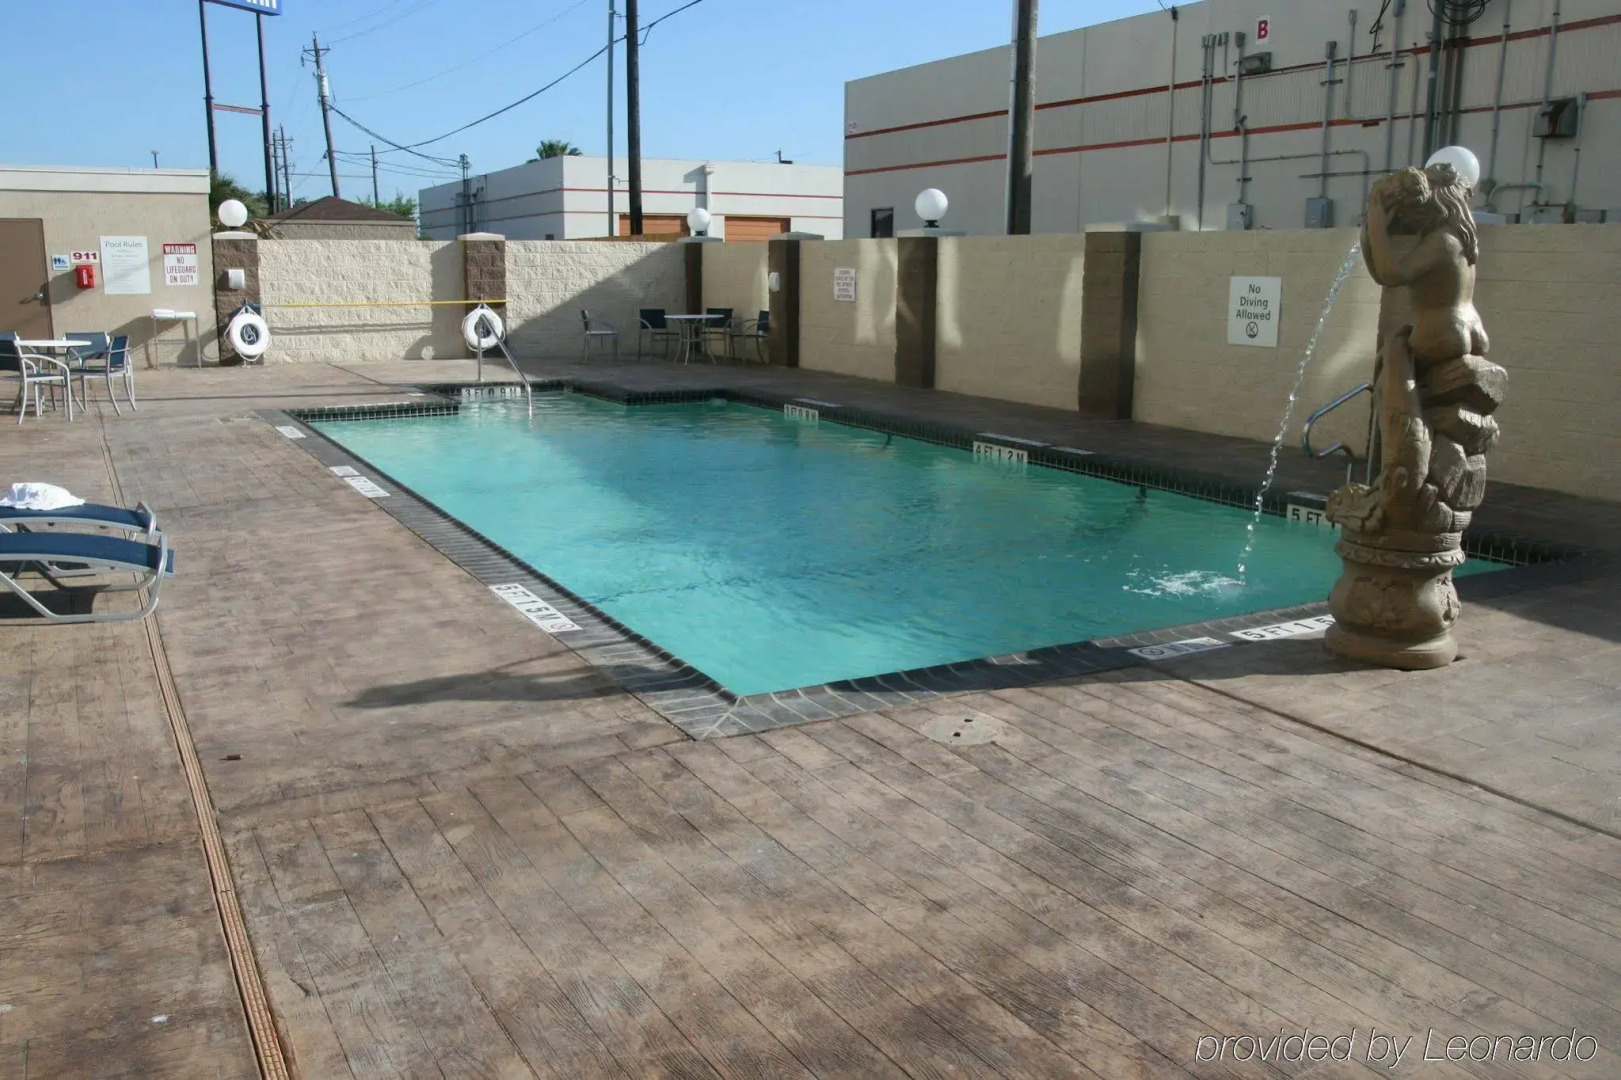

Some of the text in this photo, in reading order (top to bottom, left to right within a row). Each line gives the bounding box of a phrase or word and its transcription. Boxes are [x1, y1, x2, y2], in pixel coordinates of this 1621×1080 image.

[1257, 19, 1269, 40] B
[105, 240, 143, 248] Pool Rules
[164, 245, 195, 254] WARNING
[72, 252, 98, 260] 911
[176, 256, 185, 264] NO
[166, 265, 197, 274] LIFEGUARD
[169, 275, 194, 284] ON DUTY
[1248, 283, 1261, 294] No
[1240, 296, 1269, 310] Diving
[1235, 309, 1271, 321] Allowed
[975, 444, 981, 454] 4
[984, 445, 993, 457] FT
[1291, 507, 1301, 521] 5
[1306, 510, 1322, 525] FT
[1241, 630, 1266, 640] 5
[1263, 625, 1294, 636] FT
